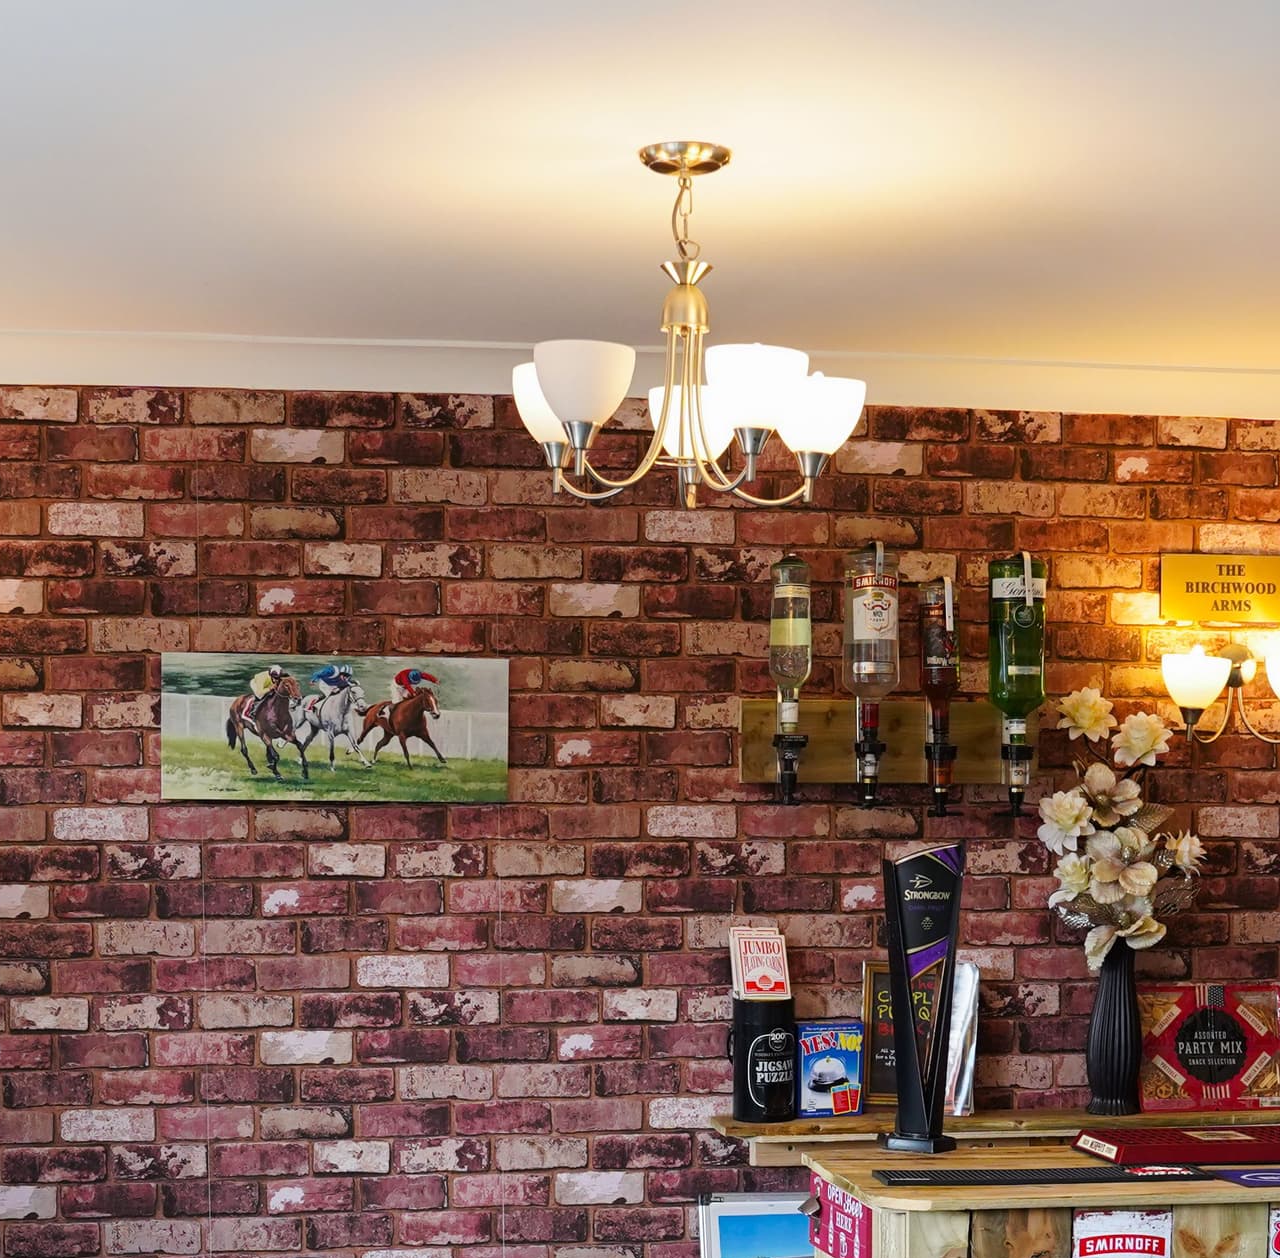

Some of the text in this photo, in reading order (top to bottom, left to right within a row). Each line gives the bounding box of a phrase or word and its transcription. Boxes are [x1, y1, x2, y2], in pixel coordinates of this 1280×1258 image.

[1216, 564, 1246, 577] THE
[1185, 582, 1277, 595] BIRCHWOOD
[1211, 600, 1252, 612] ARMS
[904, 890, 951, 901] STRONGBOW
[742, 941, 782, 955] JUMBO
[1194, 1031, 1227, 1040] ASSORTED
[799, 1031, 863, 1056] YES! NO!
[1178, 1042, 1244, 1054] PARTY MIX
[756, 1060, 793, 1072] JIGSAW
[756, 1071, 794, 1083] PUZZLE
[827, 1184, 843, 1207] OPEN
[835, 1211, 853, 1234] HERE
[1086, 1238, 1160, 1253] SMIRNOFF
